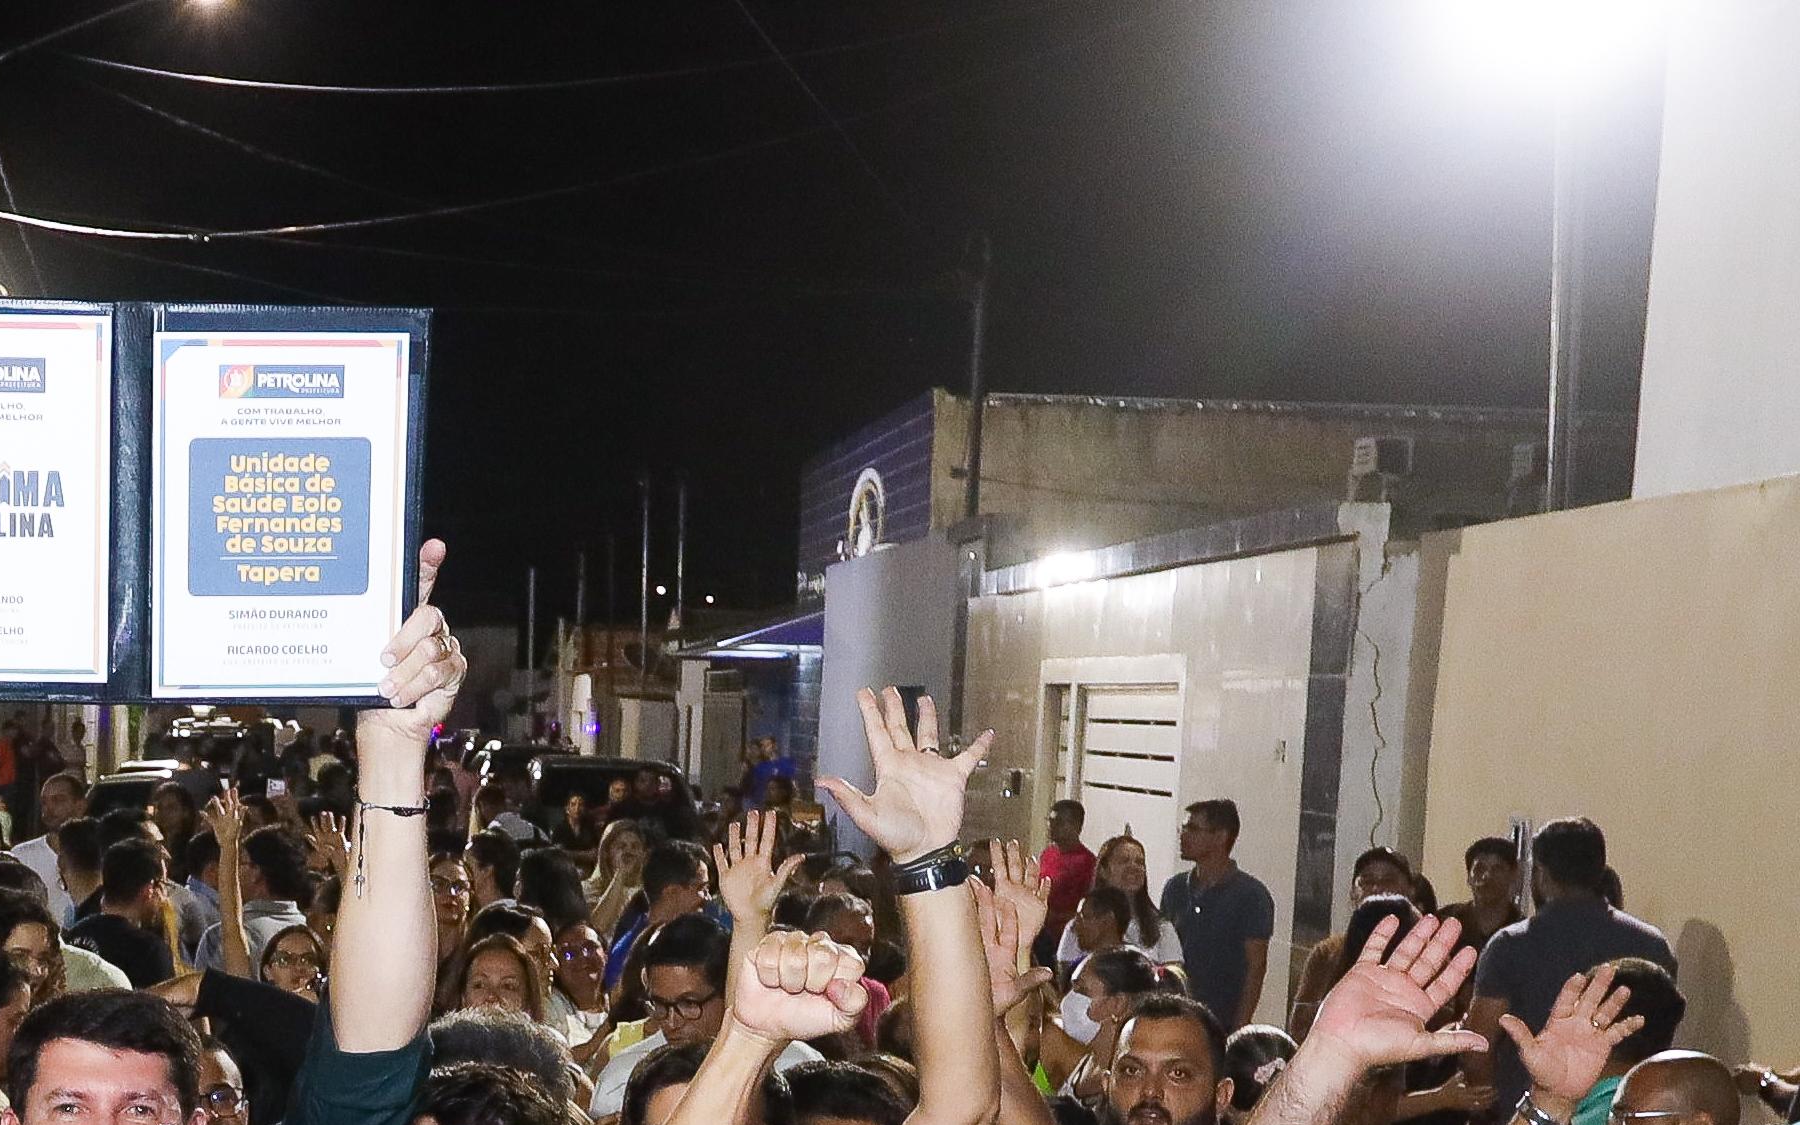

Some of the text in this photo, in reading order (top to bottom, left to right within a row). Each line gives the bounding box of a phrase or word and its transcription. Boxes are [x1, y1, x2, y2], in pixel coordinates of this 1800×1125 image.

[258, 373, 340, 394] PETROLINA
[230, 452, 331, 473] Unidade
[224, 472, 336, 493] Básica de
[212, 493, 342, 513] Saúde Eolo
[216, 514, 343, 534] Fernandes
[225, 534, 333, 554] de Souza
[236, 564, 321, 586] Tapera
[228, 608, 328, 620] SIMÃO DURANDO
[227, 644, 328, 655] RICARDO COELHO
